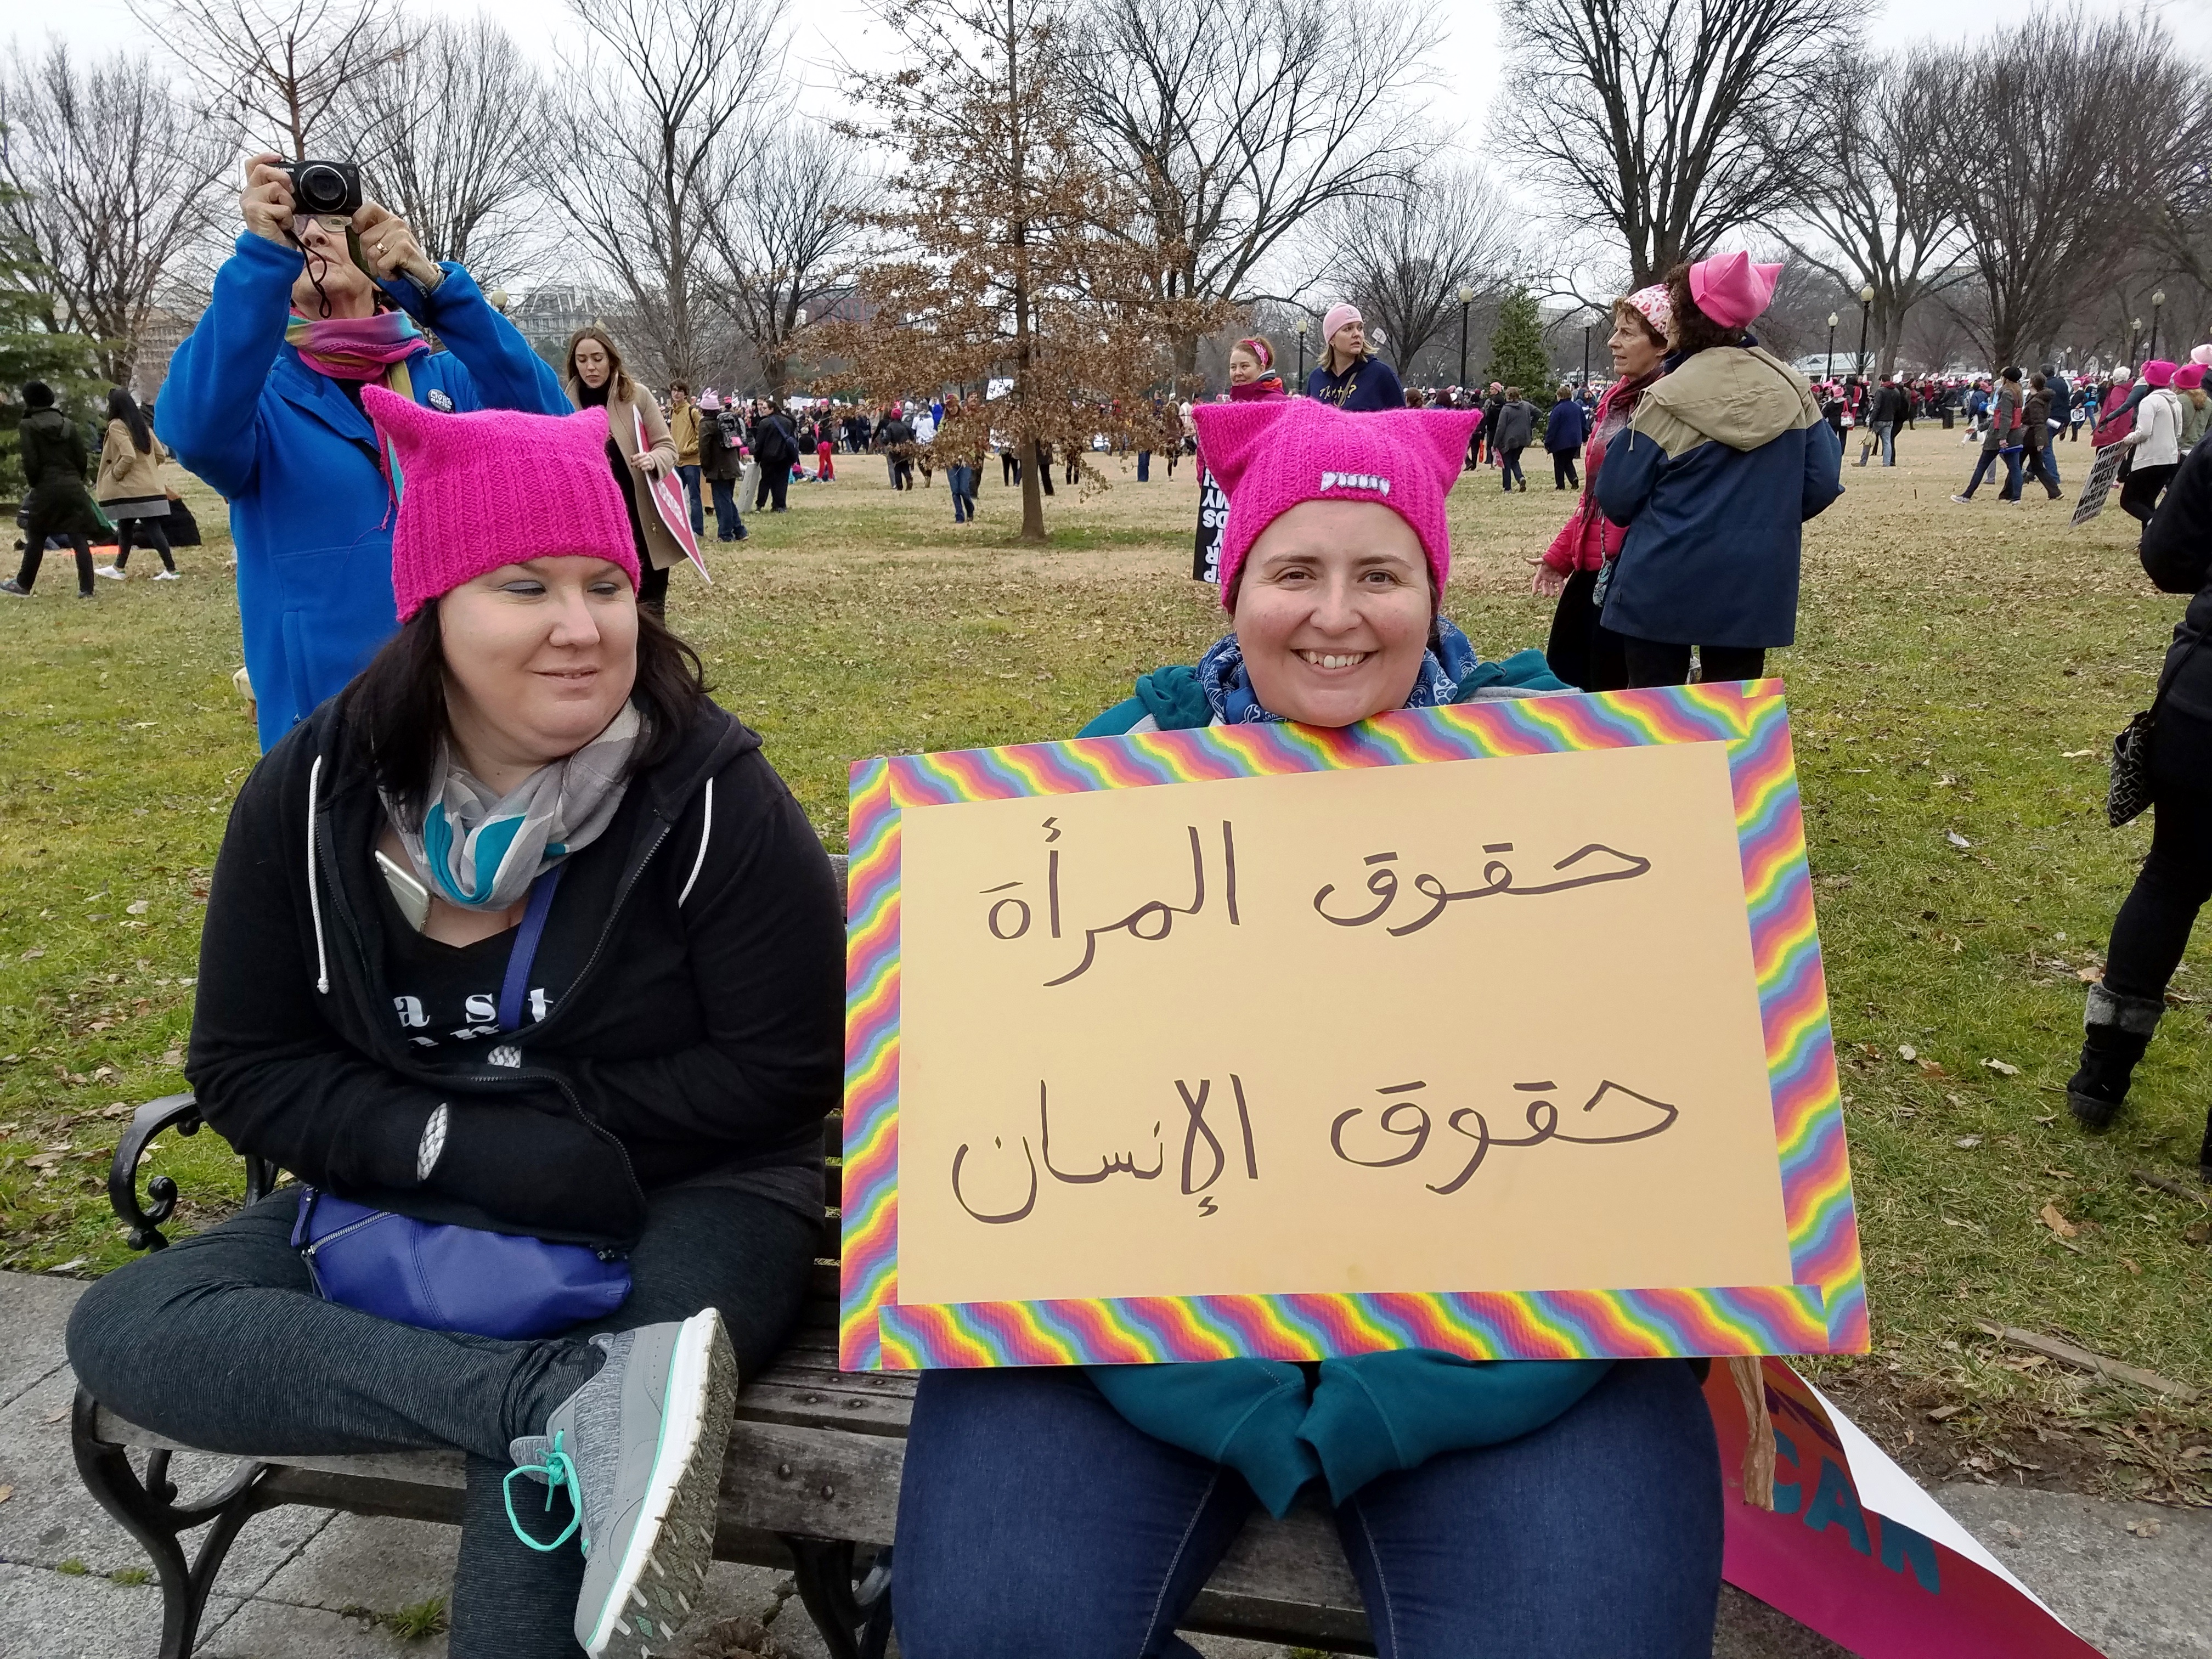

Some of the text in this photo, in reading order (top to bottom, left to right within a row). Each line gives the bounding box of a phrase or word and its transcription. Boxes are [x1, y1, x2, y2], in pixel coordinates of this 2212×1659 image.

[2089, 465, 2115, 489] MESS
[2097, 442, 2122, 461] THOU
[979, 817, 1651, 986] حقوق المرأة
[952, 1074, 1678, 1224] حقوق الإنسان
